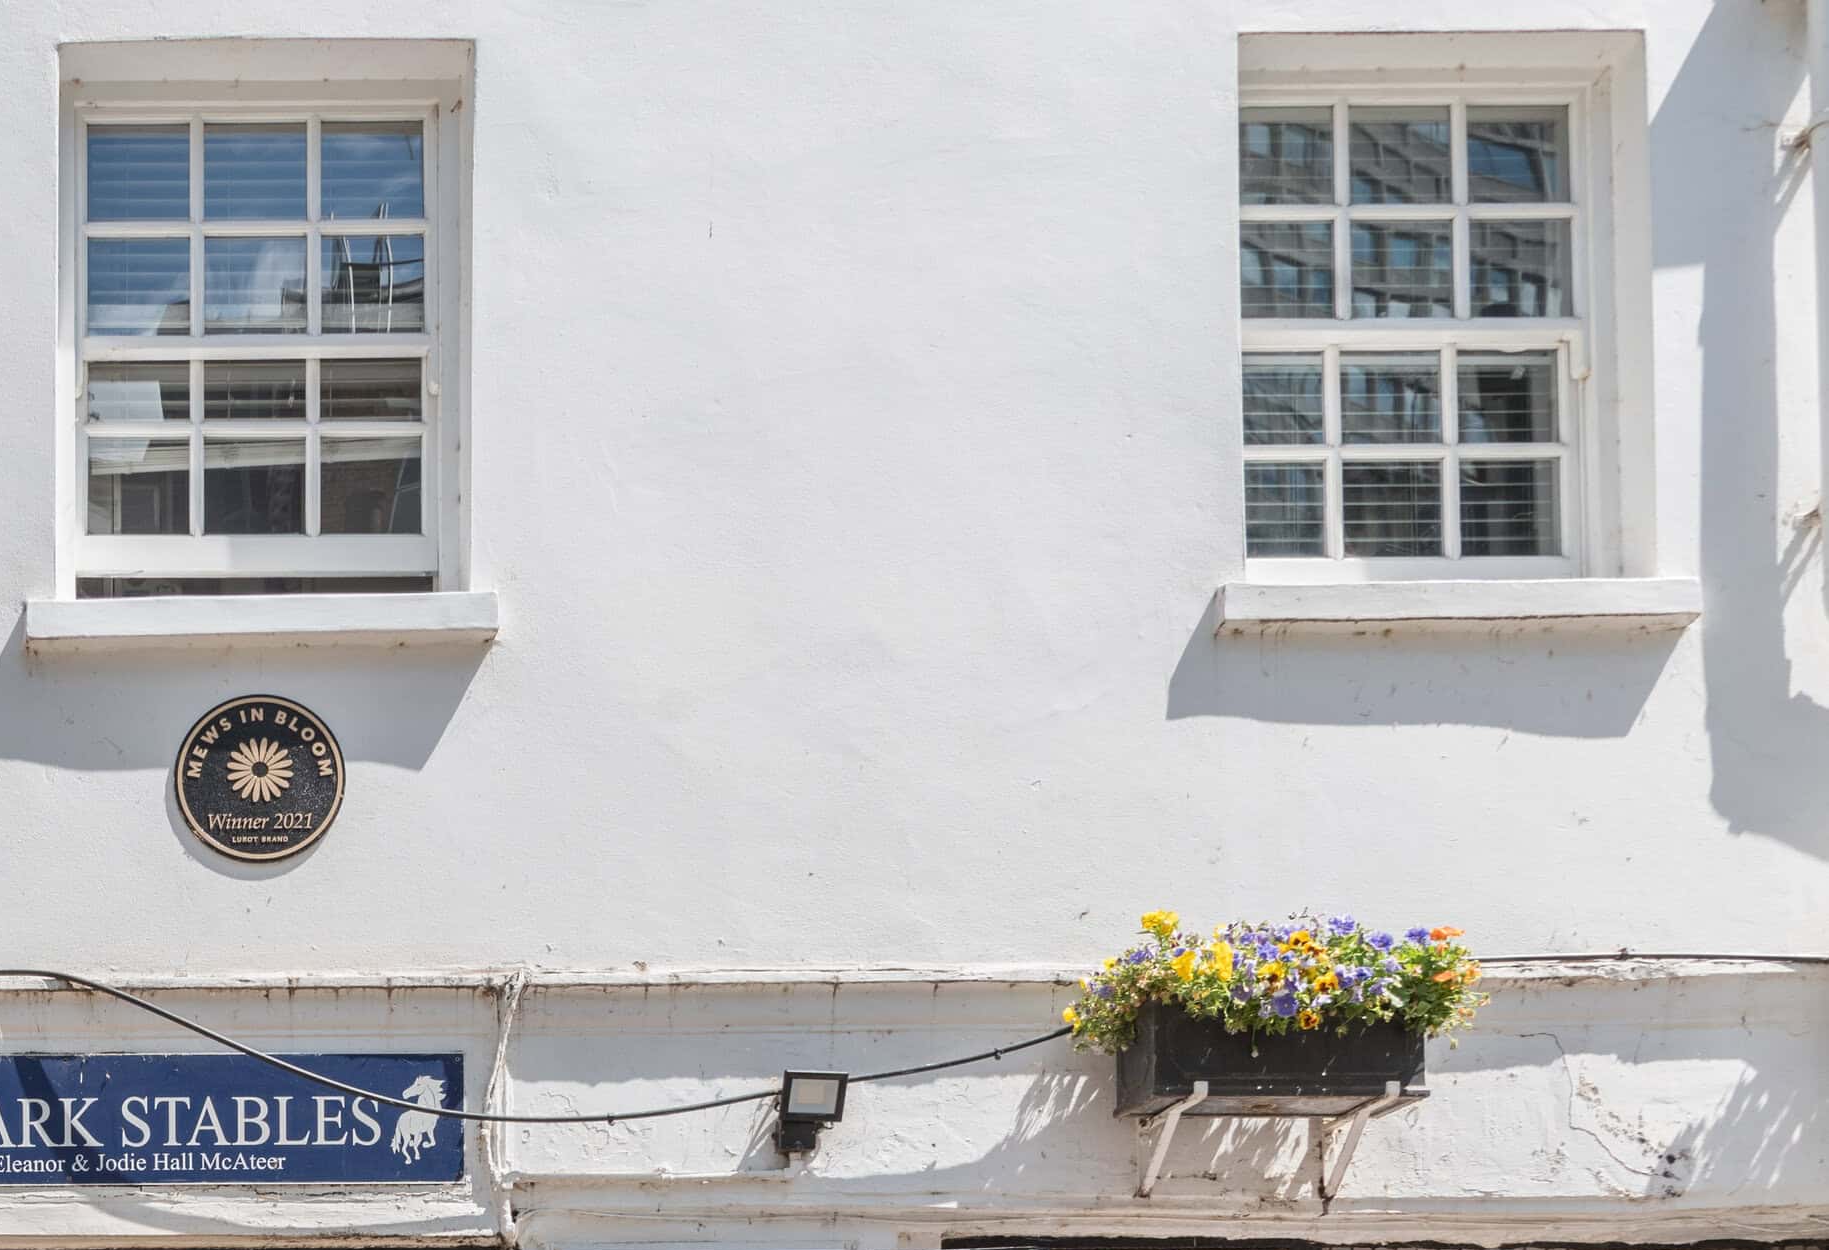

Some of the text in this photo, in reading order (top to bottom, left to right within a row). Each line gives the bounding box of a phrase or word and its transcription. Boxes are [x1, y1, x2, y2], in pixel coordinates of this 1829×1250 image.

[187, 708, 334, 779] MEWS IN BLOOM
[207, 812, 314, 830] Winner 2021
[261, 836, 289, 844] BRAND
[120, 1095, 381, 1148] STABLES
[71, 1154, 89, 1173] &
[96, 1153, 147, 1172] Jodie
[153, 1152, 194, 1171] Hall
[200, 1152, 287, 1171] McAteer
